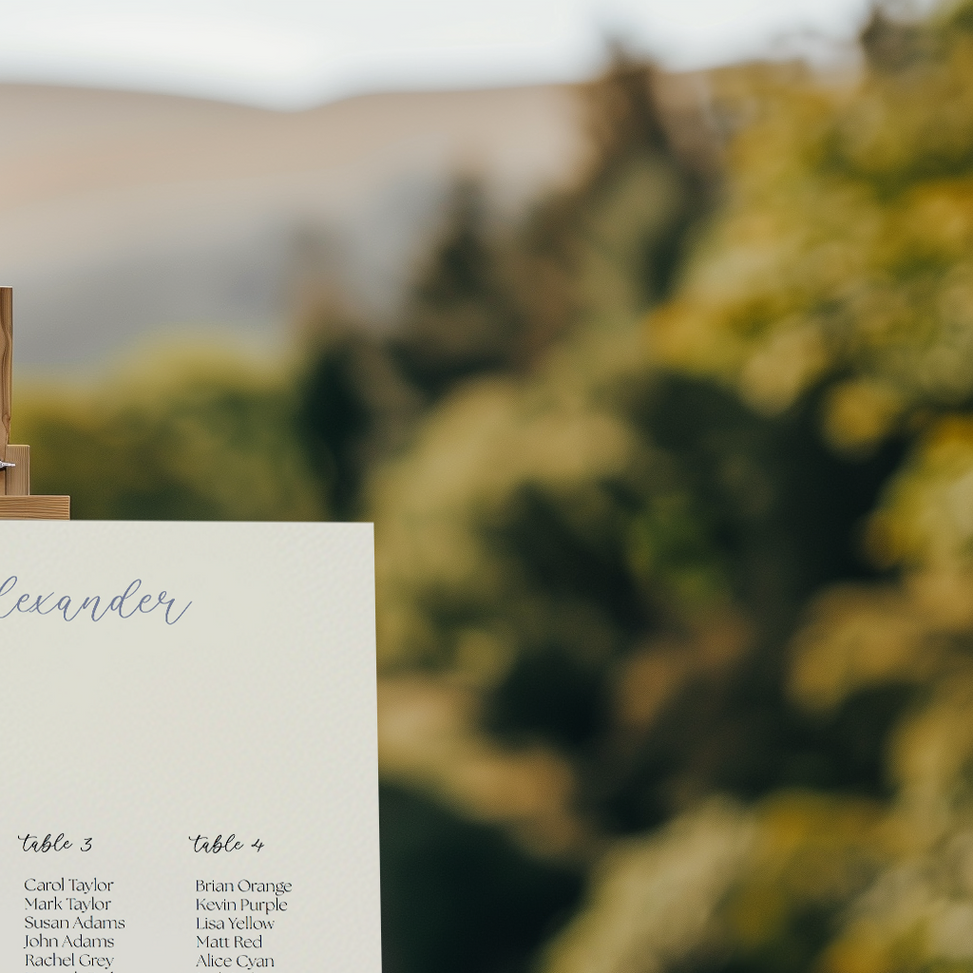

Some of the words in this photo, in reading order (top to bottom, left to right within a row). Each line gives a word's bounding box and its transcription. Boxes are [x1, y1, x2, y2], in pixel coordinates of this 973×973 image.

[18, 833, 73, 853] table
[80, 837, 92, 852] 3
[188, 834, 244, 854] table
[251, 839, 265, 853] 4
[24, 877, 64, 891] Carol
[68, 877, 114, 894] Taylor
[196, 880, 234, 892] Brian
[237, 879, 292, 896] Orange
[25, 896, 62, 910] Mark
[66, 896, 112, 913] Taylor
[196, 898, 236, 911] Kevin
[241, 897, 287, 915] Purple
[25, 916, 69, 929] Susan
[73, 915, 125, 929] Adams
[196, 917, 225, 930] Lisa
[228, 916, 275, 930] Yellow
[23, 933, 58, 949] John
[62, 934, 114, 948] Adams
[196, 936, 230, 948] Matt
[234, 935, 262, 949] Red
[25, 952, 75, 967] Rachel
[79, 954, 114, 970] Grey
[196, 953, 232, 968] Alice
[236, 955, 274, 970] Cyan
